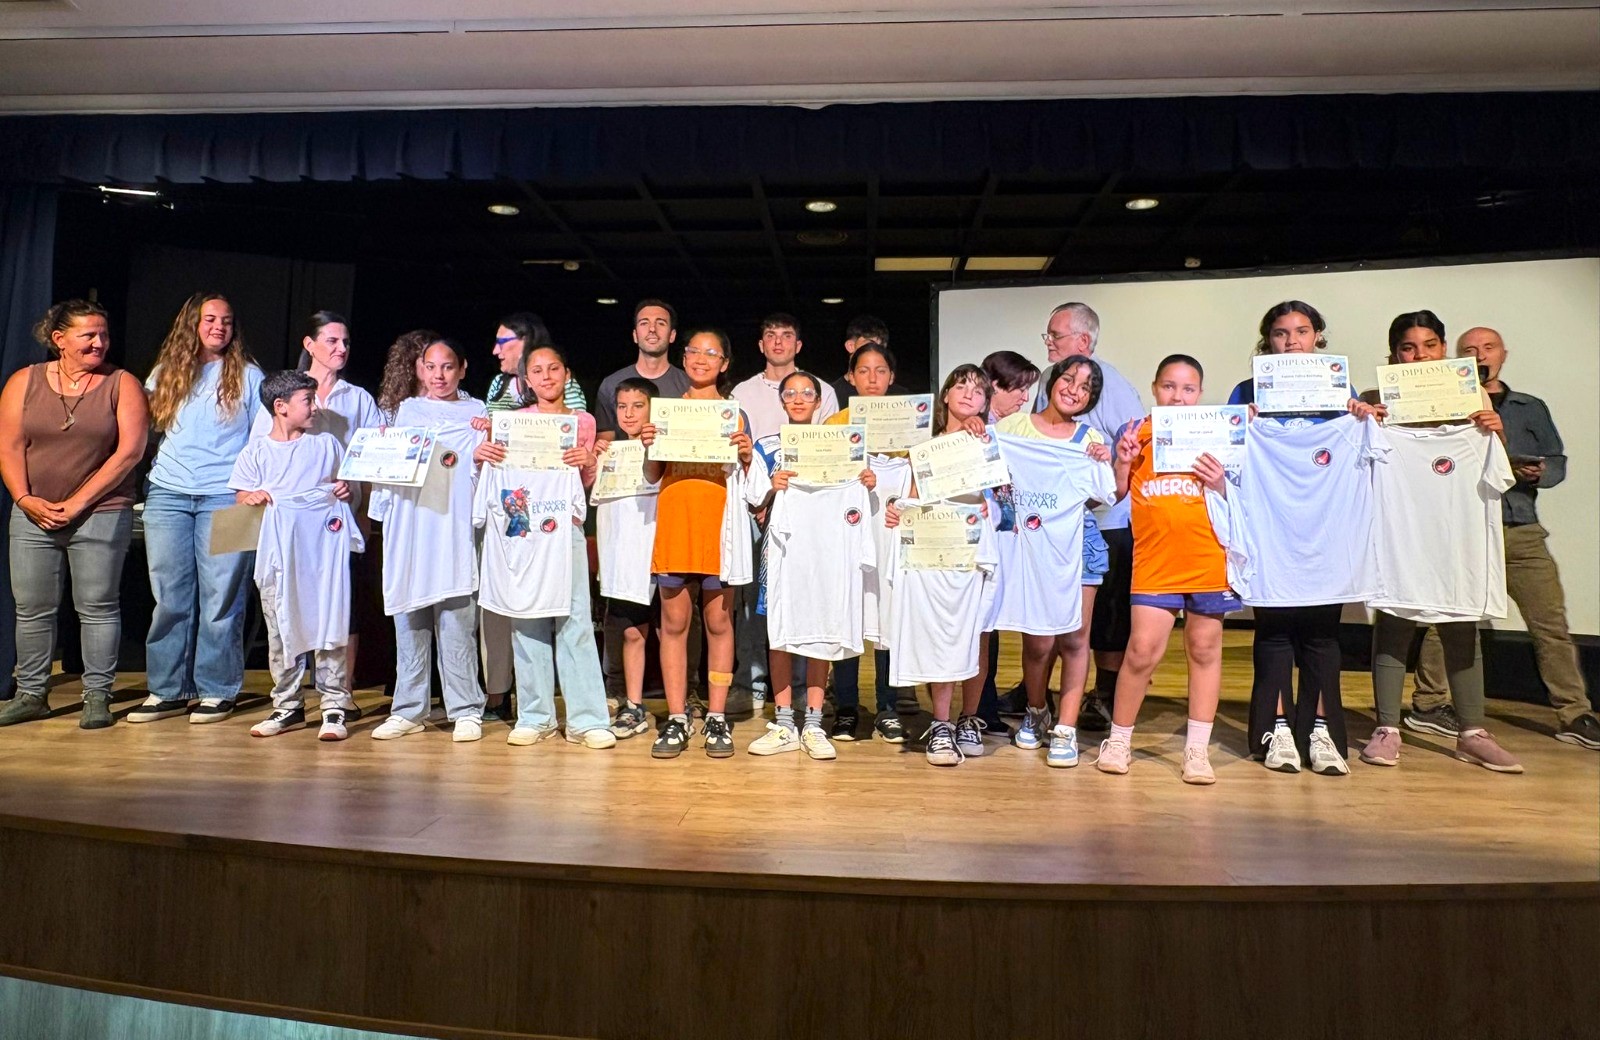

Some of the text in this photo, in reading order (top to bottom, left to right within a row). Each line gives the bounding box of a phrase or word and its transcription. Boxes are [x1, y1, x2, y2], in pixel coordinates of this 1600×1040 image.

[1277, 358, 1326, 367] DIPLOMA
[1402, 365, 1453, 377] DIPLOMA
[673, 405, 718, 414] DIPLOMA
[870, 400, 914, 410] DIPLOMA
[1176, 411, 1225, 420] DIPLOMA
[514, 418, 558, 427] DIPLOMA
[371, 431, 408, 439] DILOMA
[802, 431, 847, 440] DIPLOMA
[671, 462, 721, 477] ENERG
[532, 502, 567, 514] EL MAR
[1028, 498, 1058, 509] MAR
[917, 511, 961, 521] DIPLOMA
